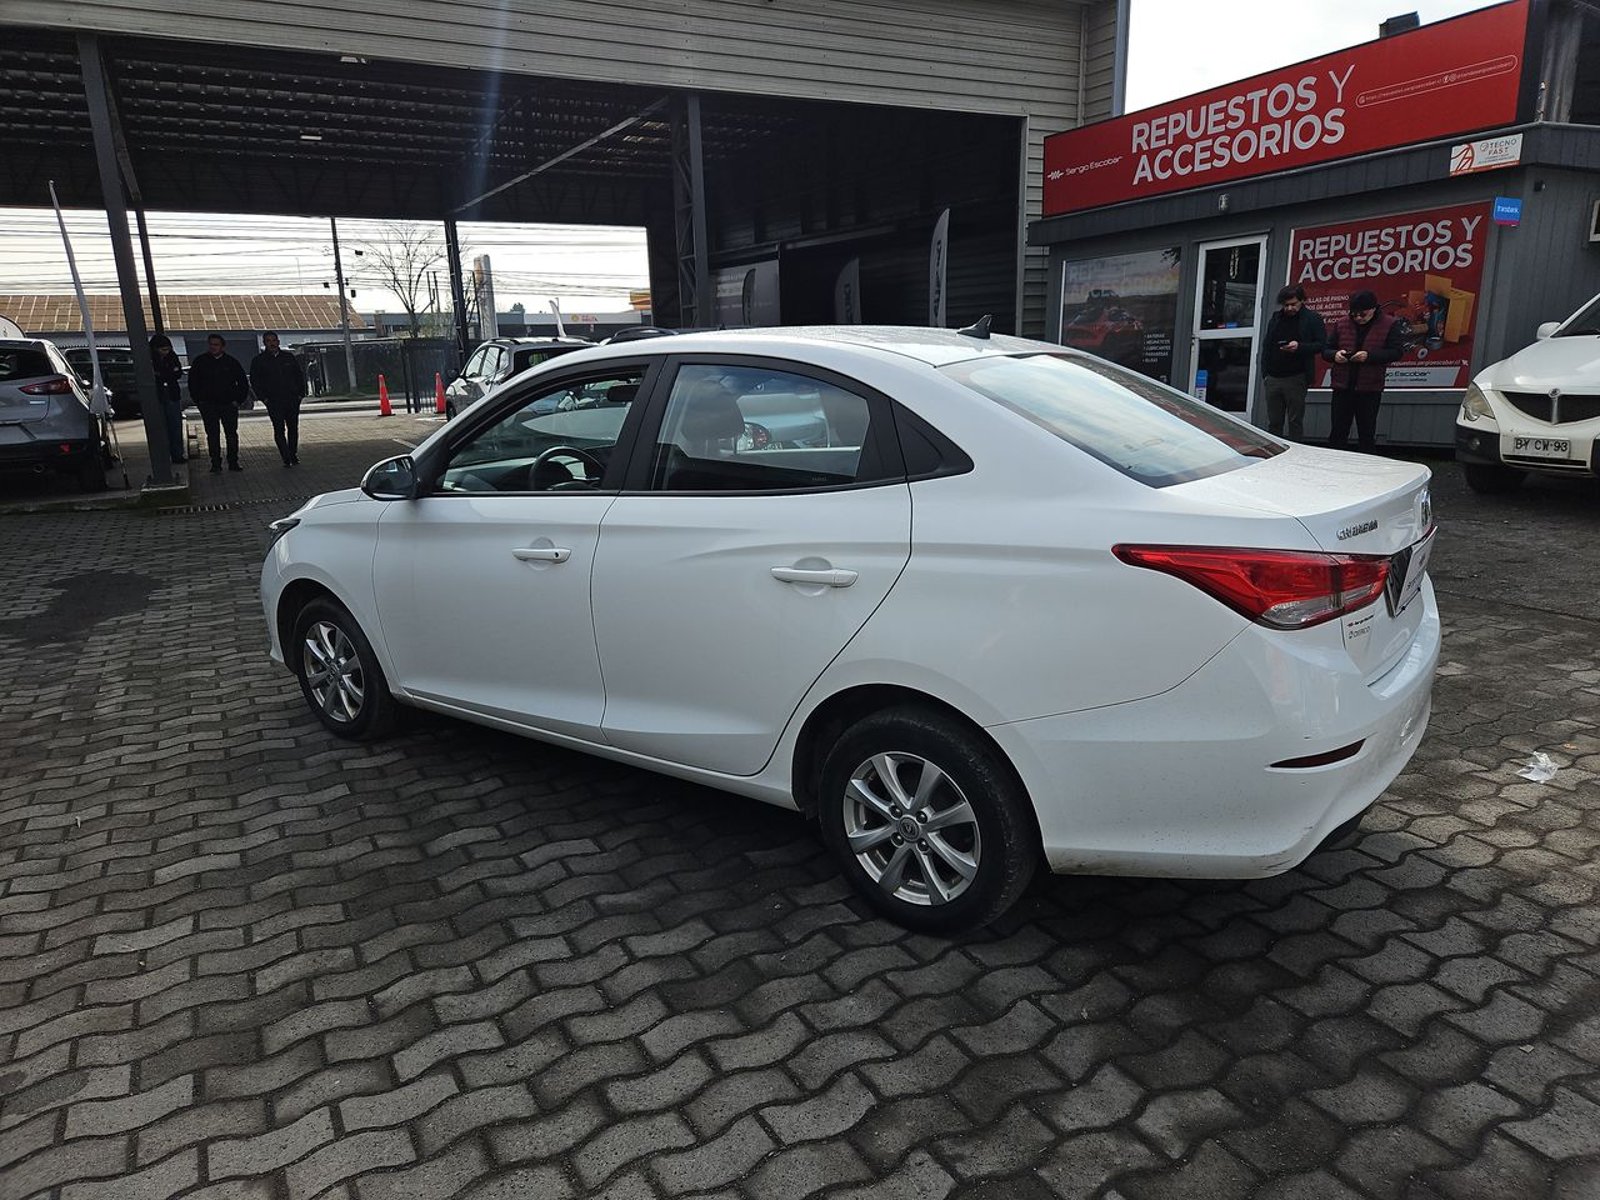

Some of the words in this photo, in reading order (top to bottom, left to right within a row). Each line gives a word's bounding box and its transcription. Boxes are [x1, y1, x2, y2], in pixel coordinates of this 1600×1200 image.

[1132, 76, 1317, 154] REPUESTOS
[1328, 64, 1356, 103] Y
[1132, 109, 1345, 185] ACCESORIOS
[1488, 147, 1509, 156] FAST
[1489, 139, 1517, 149] TECNO
[1298, 219, 1452, 261] REPUESTOS
[1460, 216, 1482, 241] Y
[1298, 243, 1473, 283] ACCESORIOS
